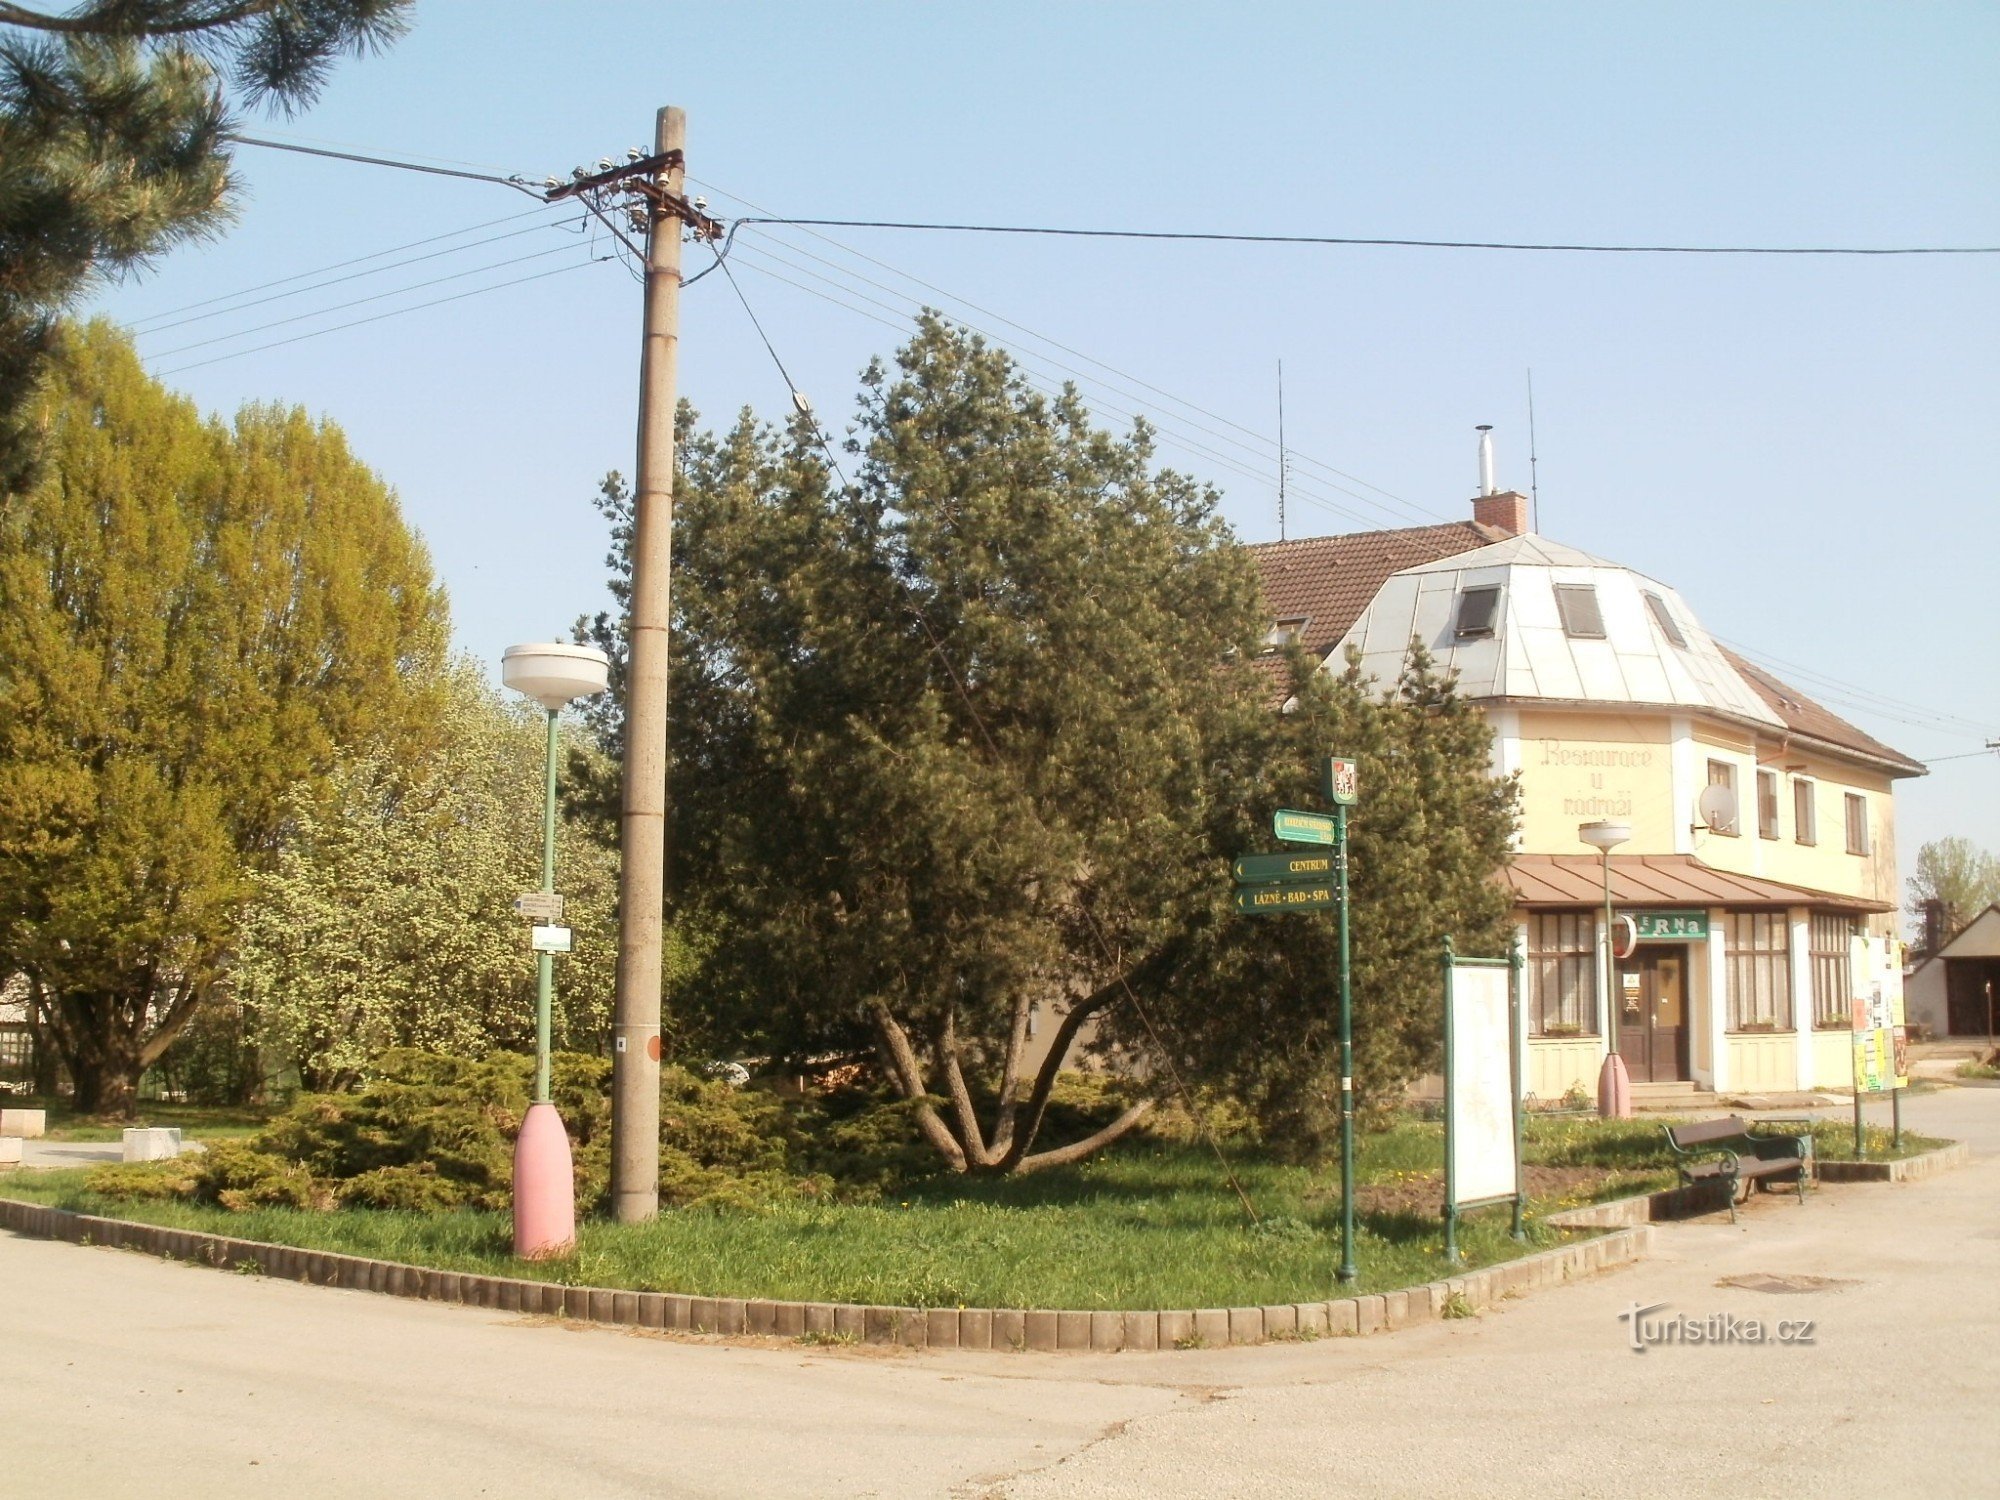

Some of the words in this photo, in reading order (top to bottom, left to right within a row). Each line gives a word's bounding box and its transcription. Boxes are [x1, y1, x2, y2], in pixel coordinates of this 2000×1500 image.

[1539, 737, 1653, 767] Restaurace
[1289, 859, 1328, 872] CENTRUM
[1288, 891, 1306, 903] BAD
[1312, 889, 1329, 901] SPA
